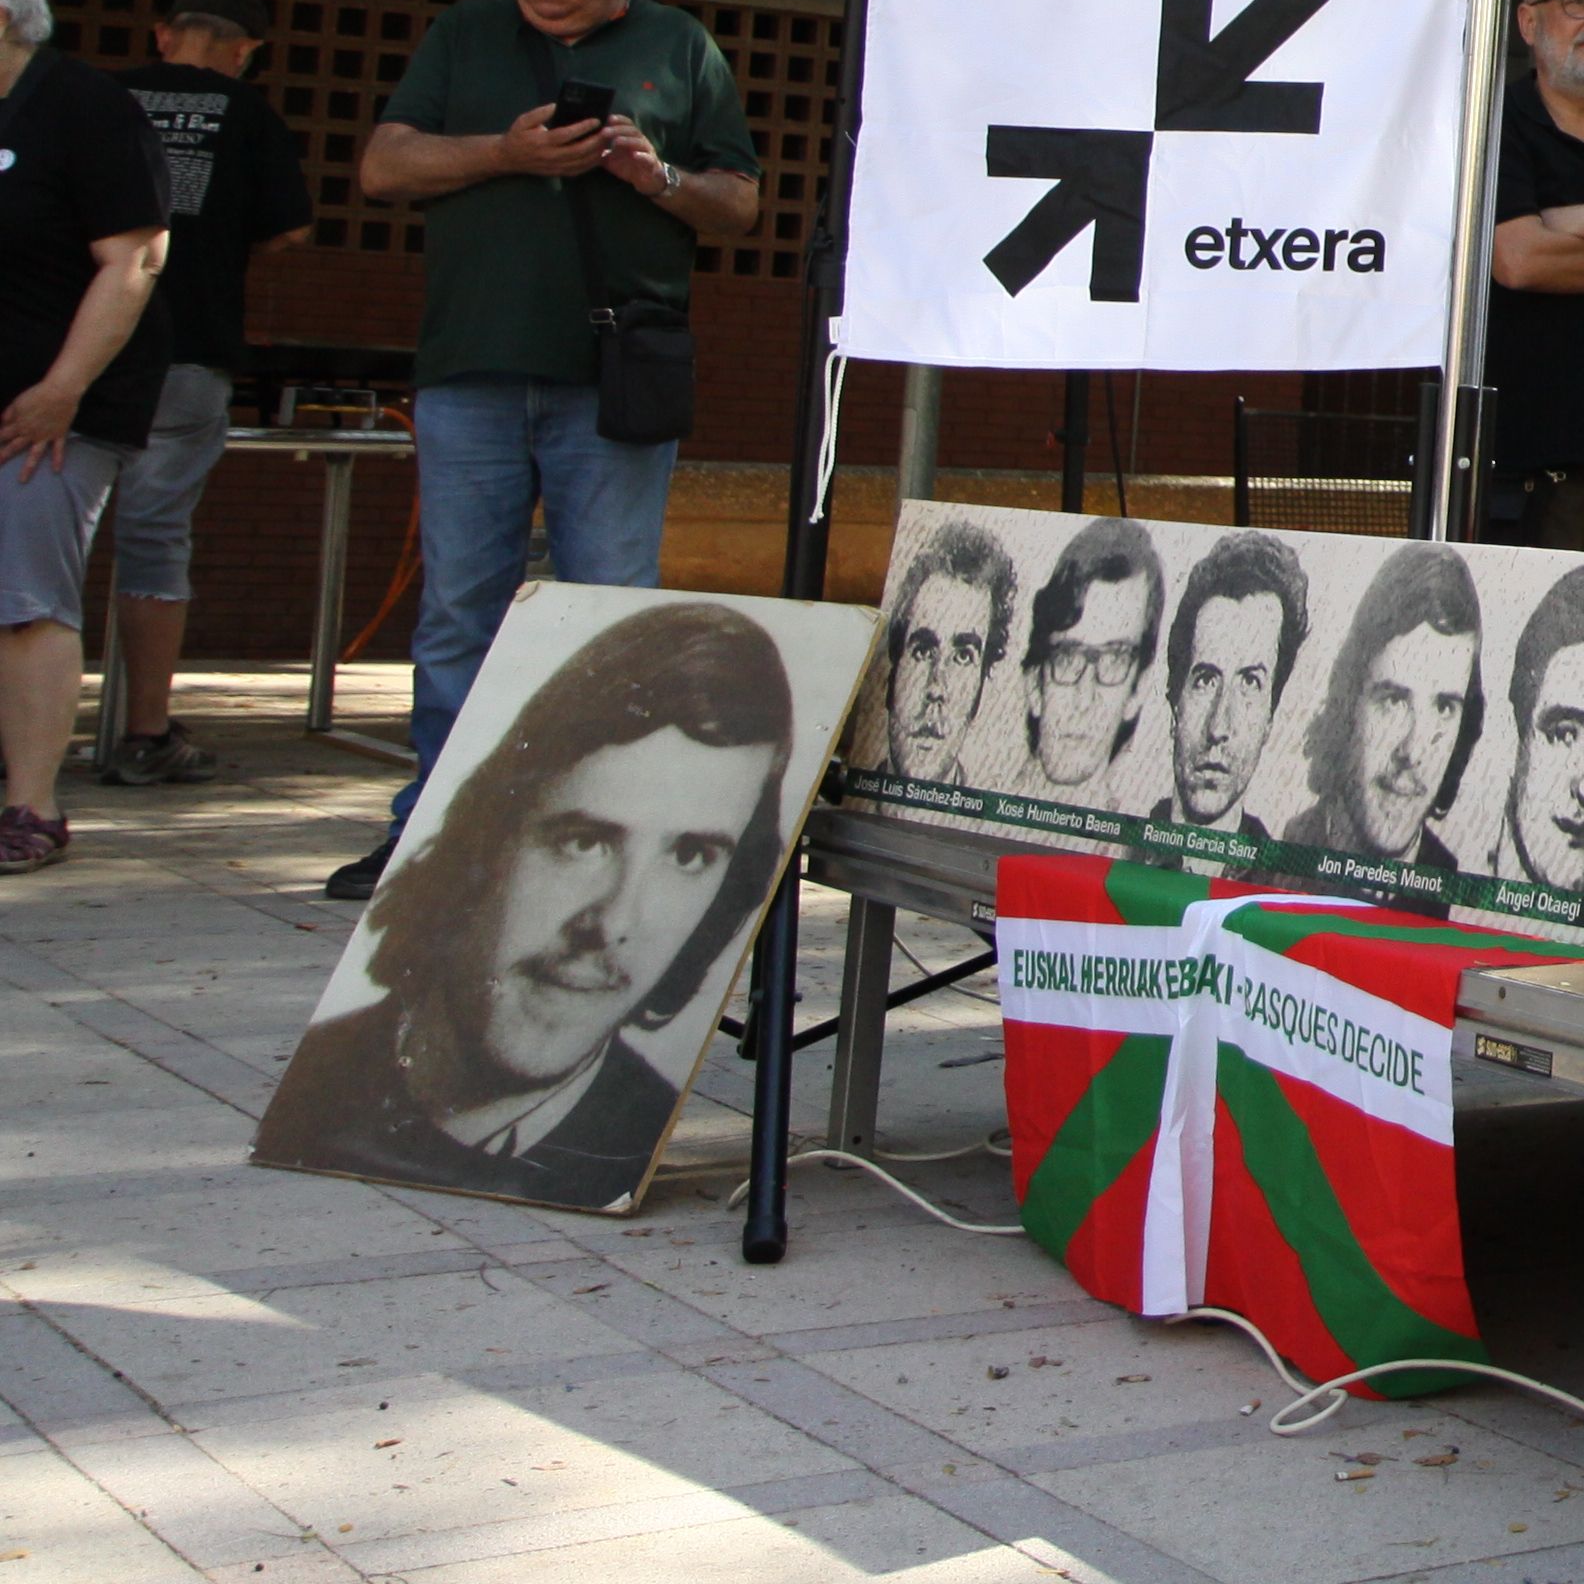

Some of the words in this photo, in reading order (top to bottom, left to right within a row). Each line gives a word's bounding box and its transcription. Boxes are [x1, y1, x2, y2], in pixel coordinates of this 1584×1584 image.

[1184, 217, 1386, 273] etxera
[854, 775, 880, 793] José
[996, 798, 1024, 818] Xosé
[1027, 805, 1083, 830] Humberto
[1086, 814, 1121, 836] Baena
[1143, 825, 1184, 847] Ramón
[1228, 839, 1258, 860] Sanz
[1317, 855, 1342, 876] Jon
[1344, 861, 1398, 886] Paredes
[1400, 870, 1443, 893] Manot
[1536, 892, 1582, 918] Otaegi
[1013, 948, 1078, 993] EUSKAL
[1081, 955, 1163, 1000] HERRIAK
[1341, 1018, 1426, 1096] DECIDE
